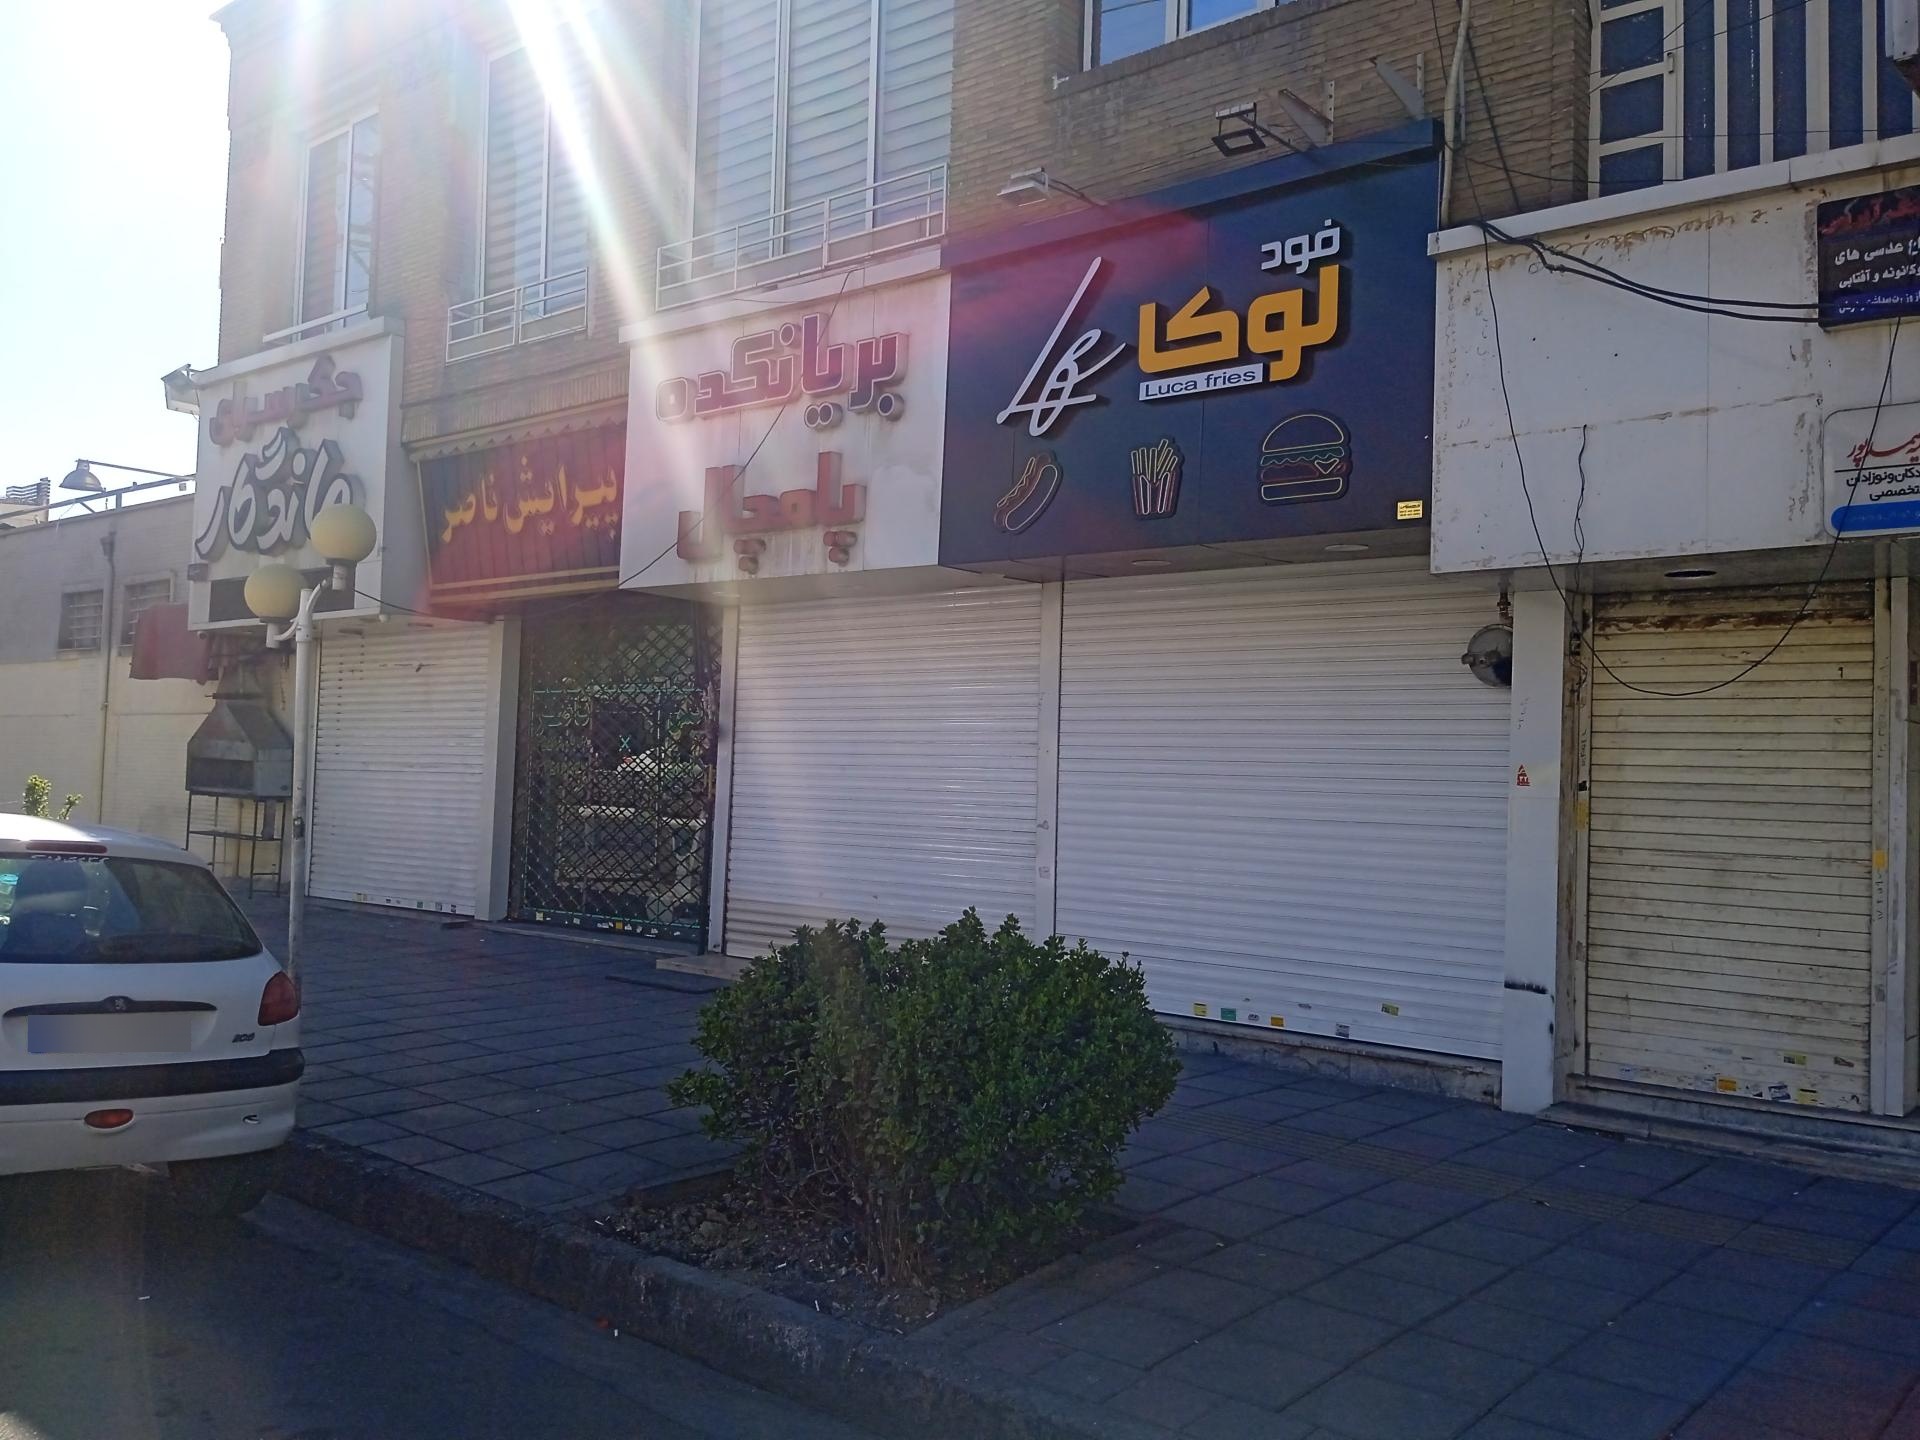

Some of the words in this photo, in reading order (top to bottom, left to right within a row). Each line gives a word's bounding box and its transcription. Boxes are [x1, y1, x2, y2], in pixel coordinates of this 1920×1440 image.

[1261, 219, 1340, 274] فود
[1834, 248, 1860, 266] های
[1863, 242, 1904, 262] عدسی
[1838, 268, 1871, 289] آفتابی
[1138, 264, 1340, 382] لوکا
[656, 311, 908, 429] بریانکده
[1145, 379, 1198, 398] Luca
[1204, 370, 1256, 388] fries
[440, 470, 499, 544] ناصر
[502, 454, 618, 541] پیرایش
